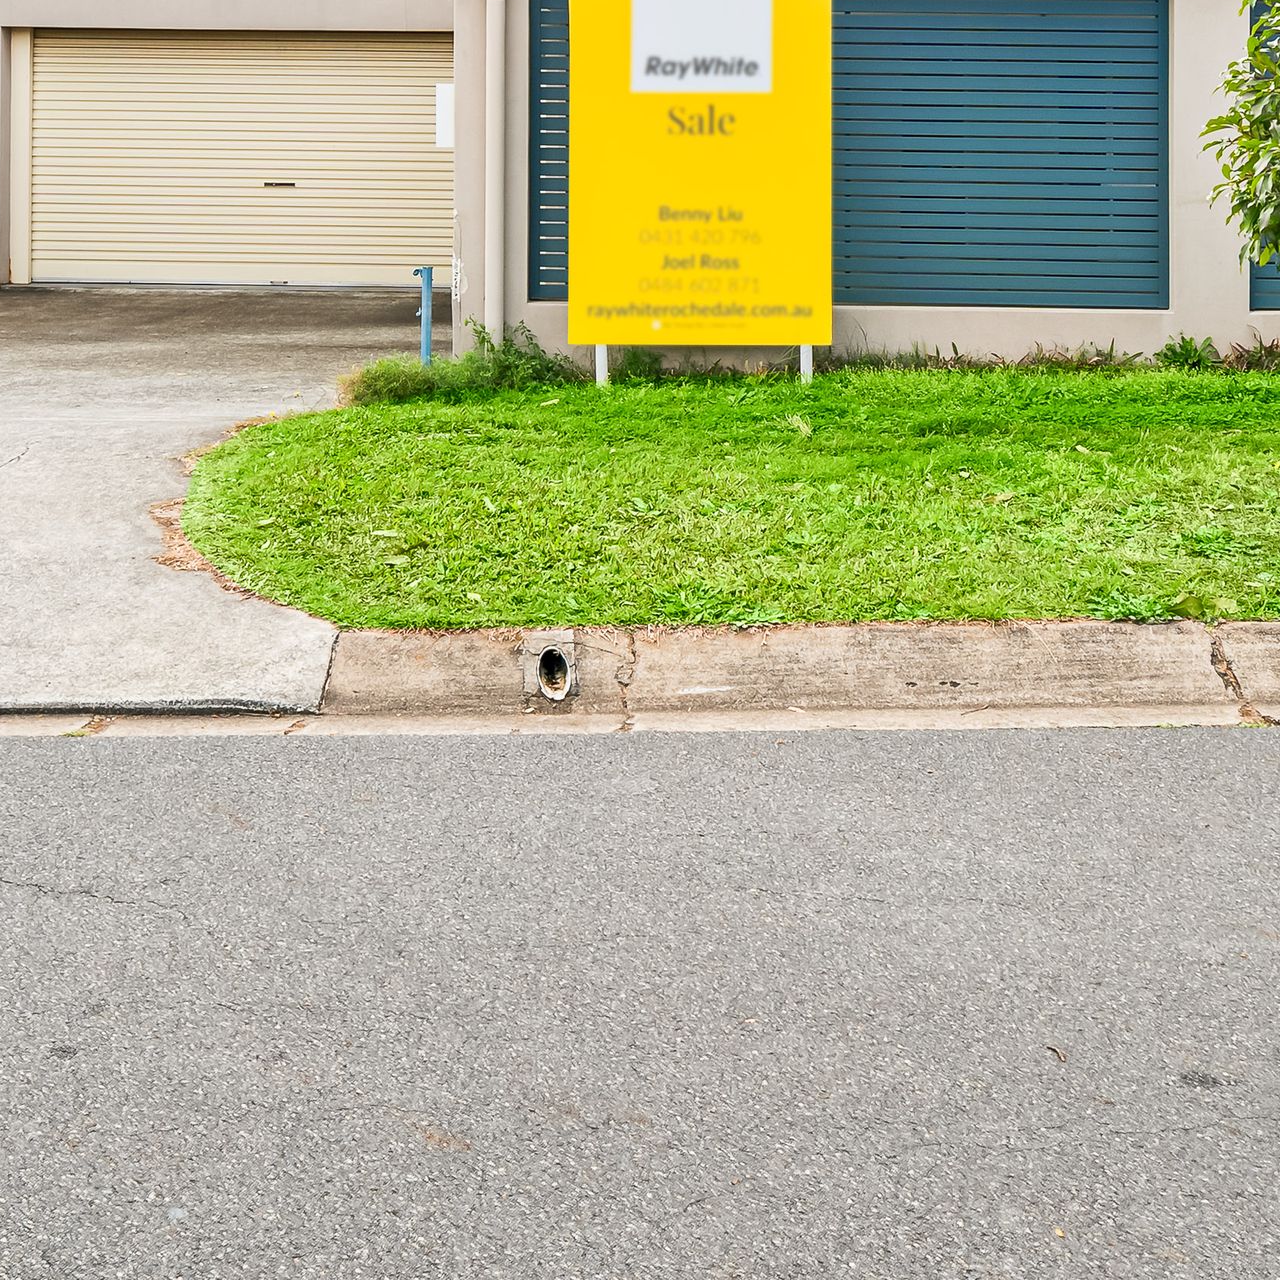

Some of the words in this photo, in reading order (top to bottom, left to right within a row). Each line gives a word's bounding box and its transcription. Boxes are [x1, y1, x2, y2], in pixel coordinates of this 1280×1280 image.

[645, 55, 760, 81] RayWhite
[667, 104, 736, 136] Sale
[658, 205, 712, 224] Benny
[717, 205, 743, 222] Liu
[661, 253, 695, 271] Joel
[700, 253, 740, 271] Ross
[587, 301, 813, 320] raywhiterochedale.com.au
